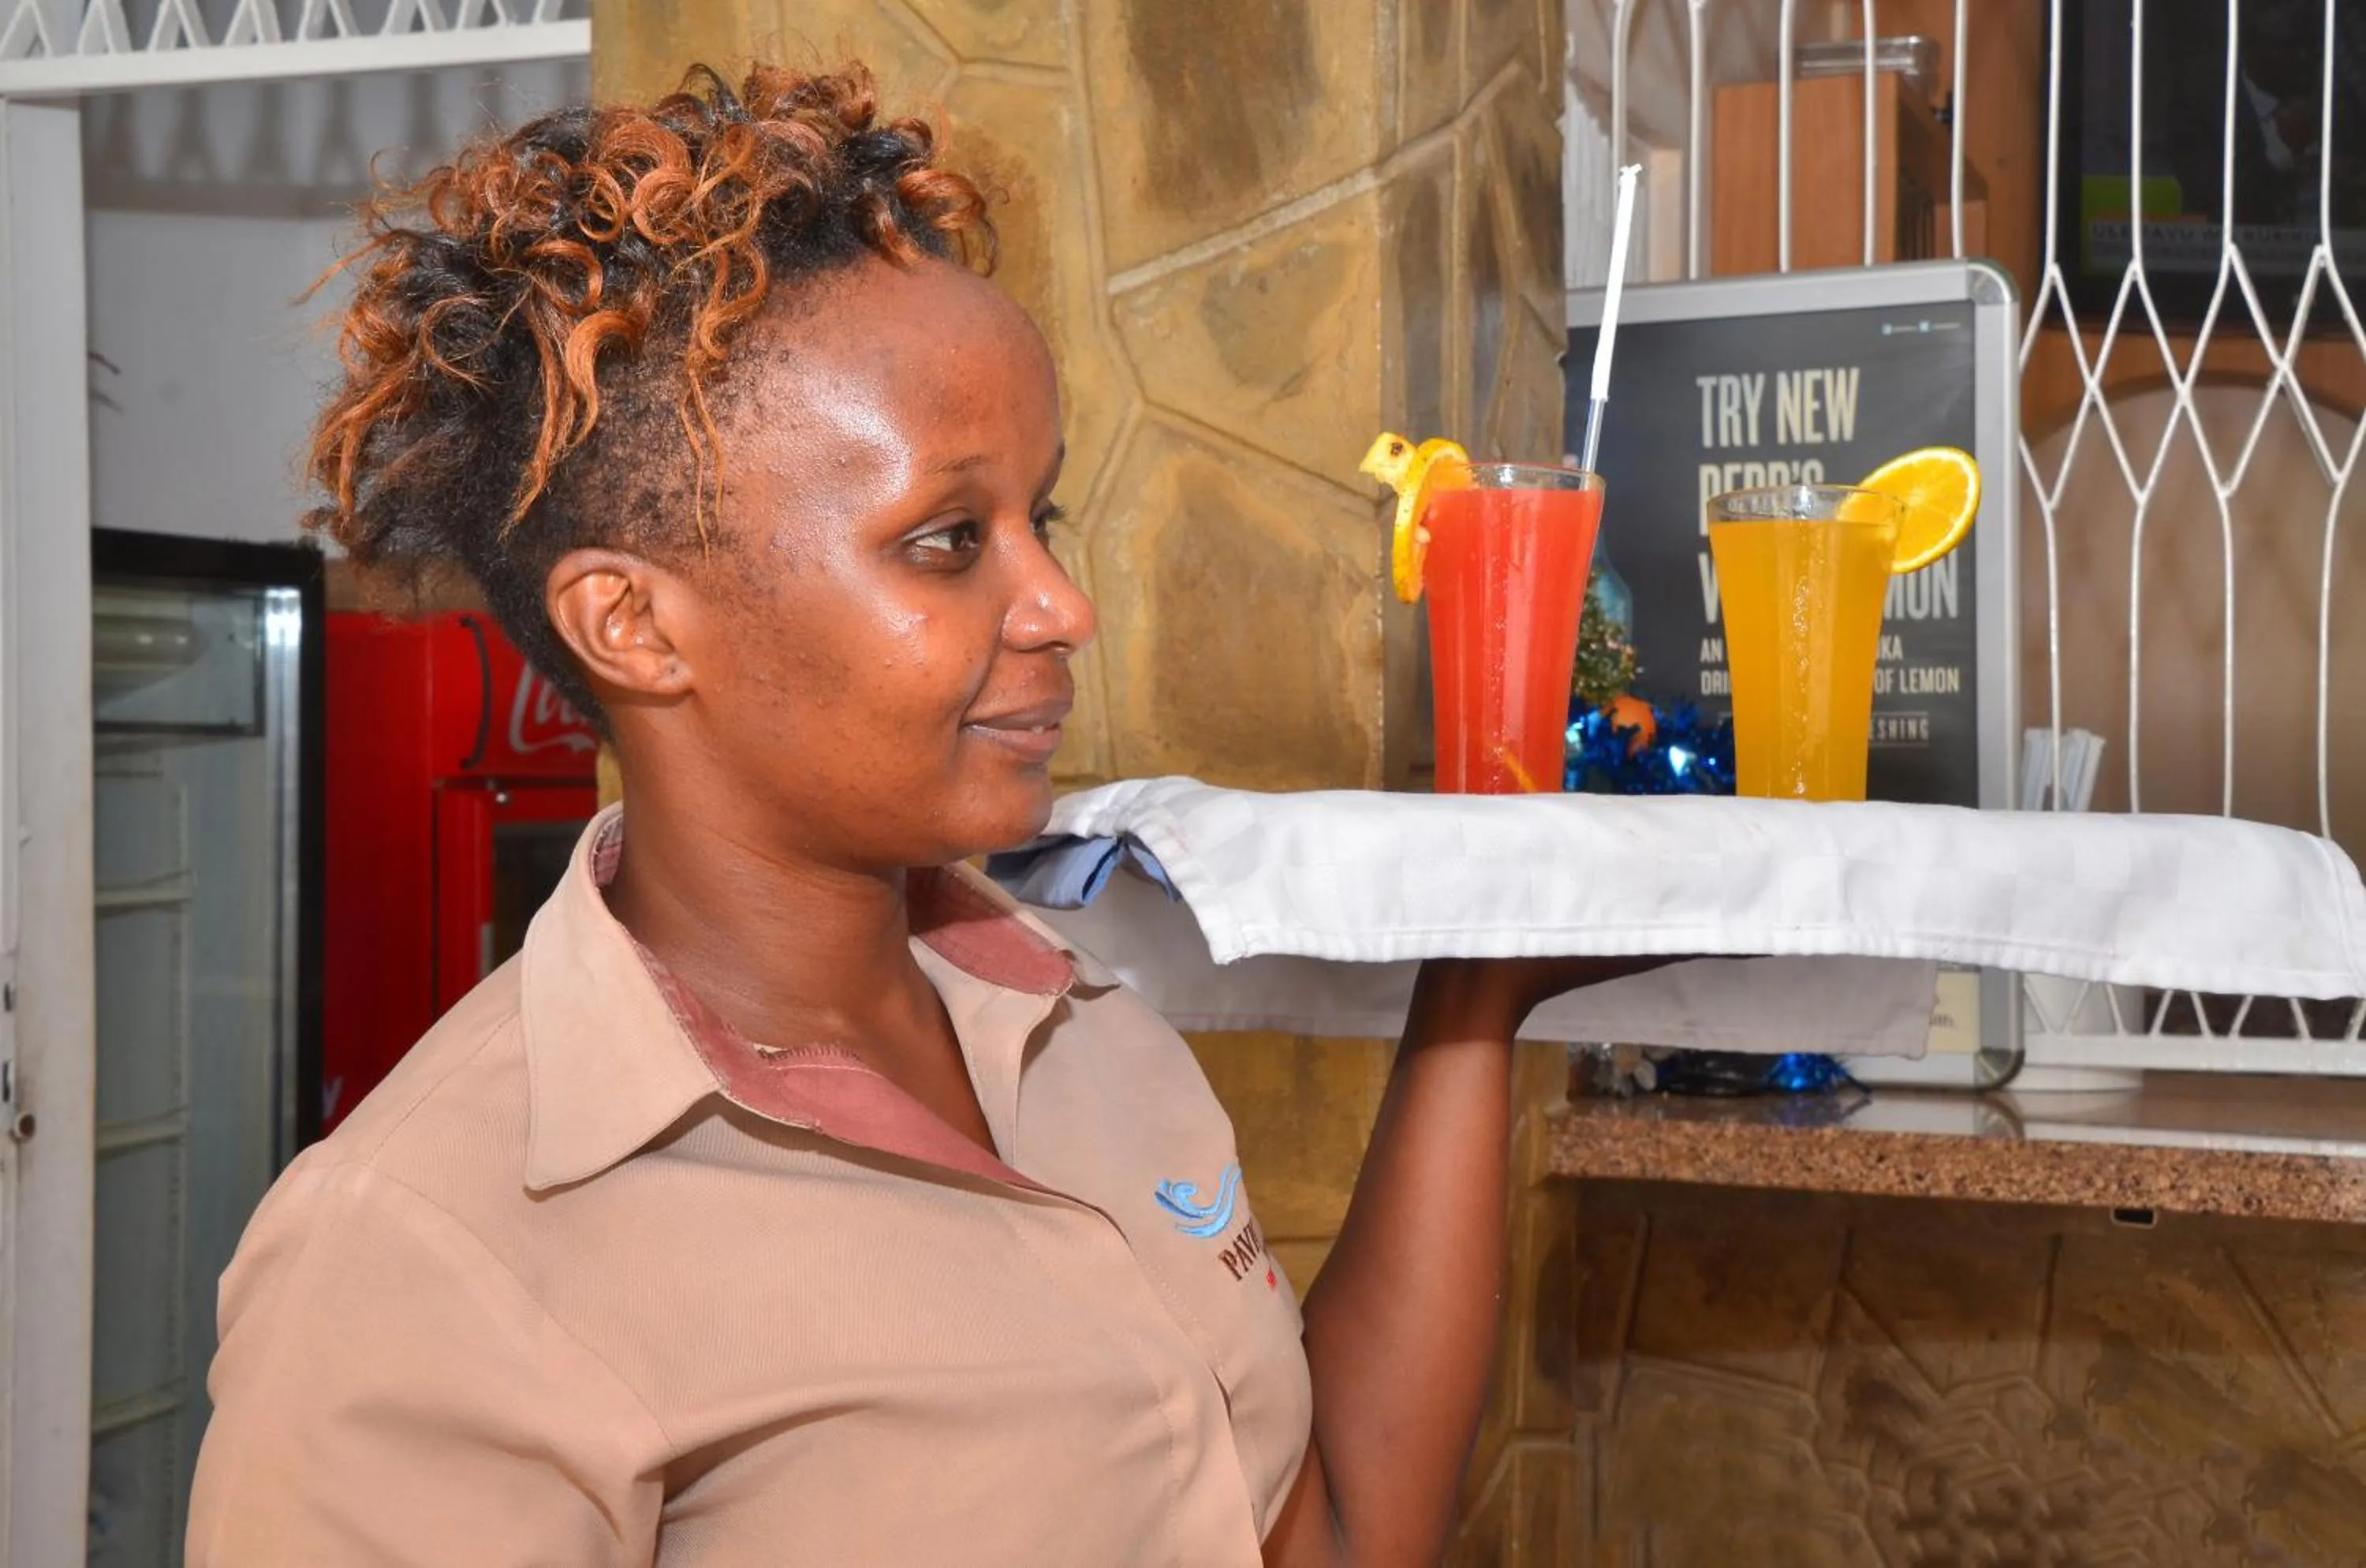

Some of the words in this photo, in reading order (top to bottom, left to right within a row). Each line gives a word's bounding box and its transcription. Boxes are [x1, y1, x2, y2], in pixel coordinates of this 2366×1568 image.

[1696, 373, 1766, 448] TRY
[1776, 367, 1860, 445] NEW
[1700, 637, 1723, 663] AN
[1701, 670, 1732, 695] DRI
[1875, 668, 1894, 693] OF
[1899, 666, 1960, 693] LEMON
